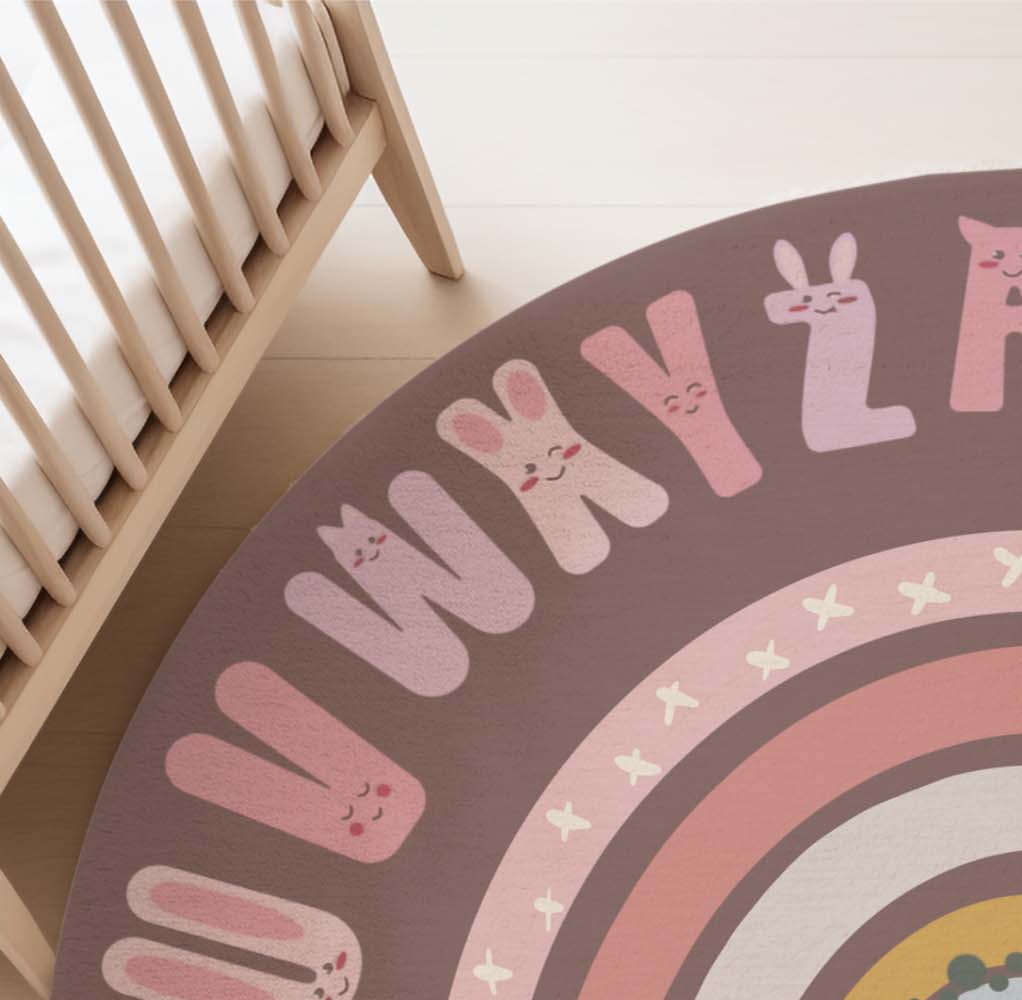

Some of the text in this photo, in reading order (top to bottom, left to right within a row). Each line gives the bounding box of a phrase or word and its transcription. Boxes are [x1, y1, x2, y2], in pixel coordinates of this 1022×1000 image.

[580, 290, 763, 497] Y
[763, 232, 917, 453] Z
[437, 359, 670, 575] X
[285, 471, 535, 697] W
[166, 662, 426, 863] V
